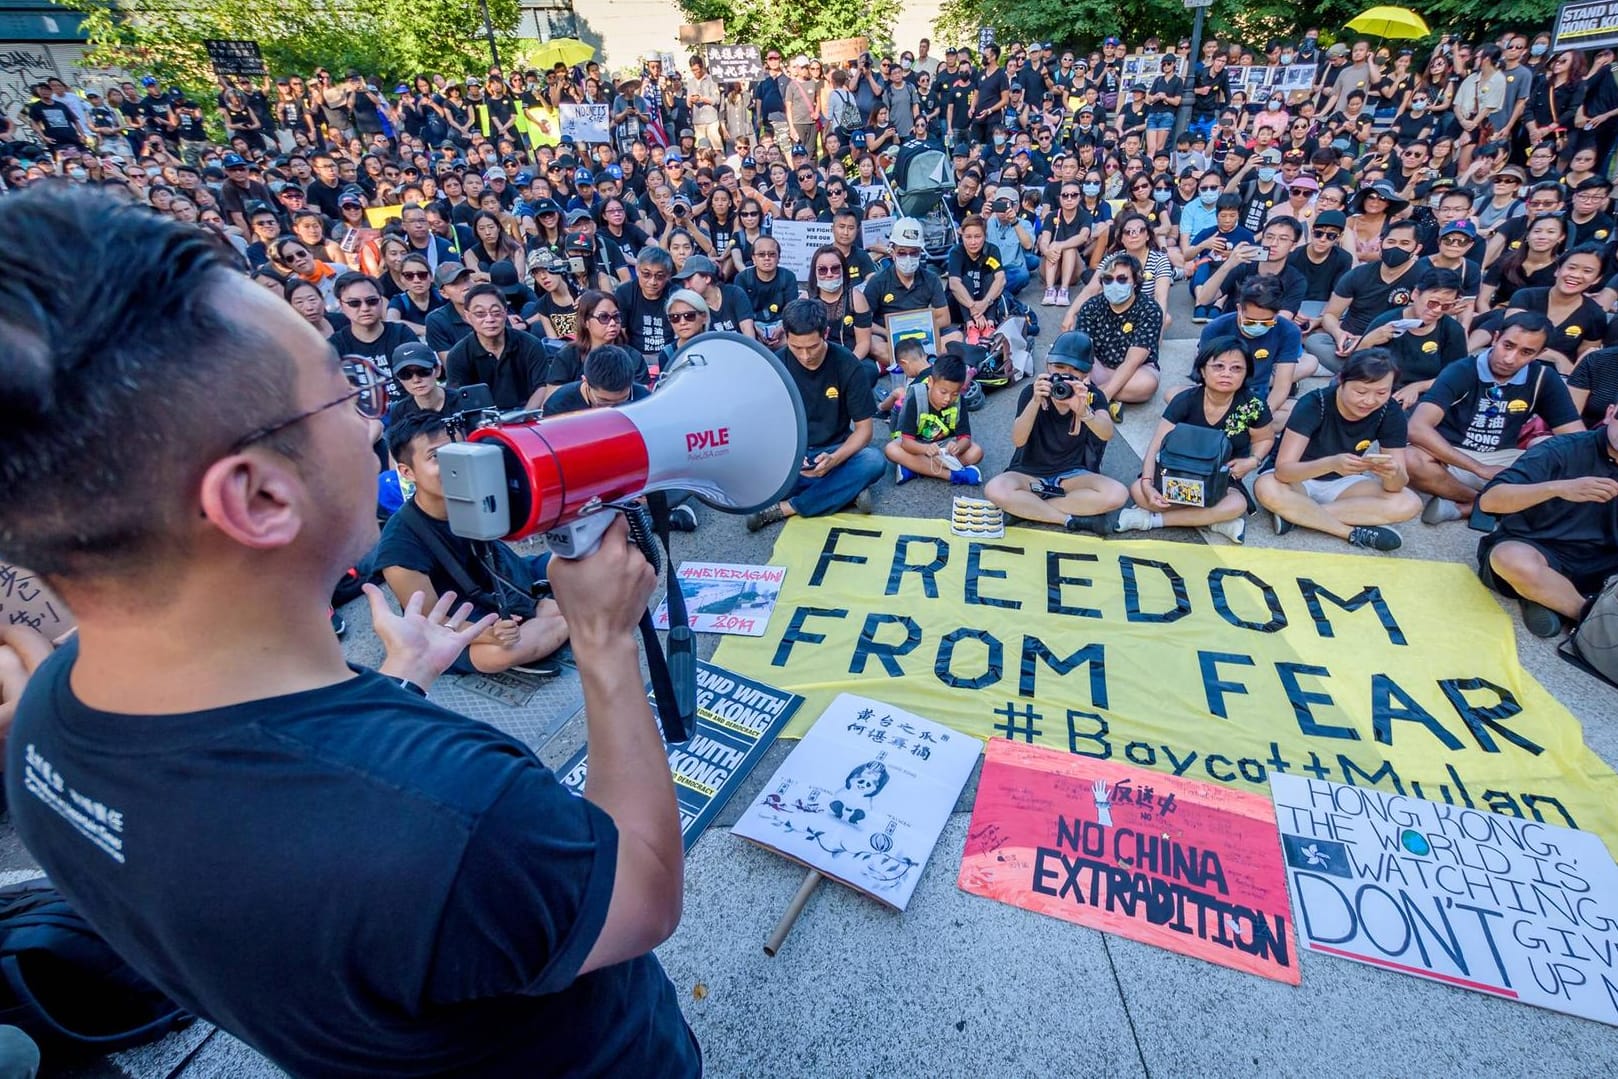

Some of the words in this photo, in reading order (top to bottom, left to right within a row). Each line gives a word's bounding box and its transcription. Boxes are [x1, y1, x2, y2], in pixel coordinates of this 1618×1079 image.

[1560, 19, 1599, 33] HONG
[1563, 5, 1607, 22] STAND
[686, 428, 729, 452] PYLE
[1465, 431, 1501, 446] HONG
[808, 527, 1408, 646] FREEDOM
[710, 614, 756, 633] 2019
[732, 684, 786, 715] WITH
[771, 606, 1109, 709] FROM
[1197, 650, 1545, 756] FEAR
[711, 697, 772, 733] KONG
[668, 749, 728, 791] KONG
[687, 734, 745, 770] WITH
[677, 775, 715, 796] DEMOCRACY
[1111, 778, 1178, 818] 反送中
[1308, 779, 1423, 828] HONG
[1056, 815, 1105, 857] NO
[1114, 828, 1230, 896] CHINA
[1278, 803, 1357, 844] THE
[1524, 854, 1592, 893] IS
[1032, 846, 1290, 968] EXTRADITION
[1347, 846, 1618, 932] WATCHING
[1294, 871, 1514, 989] DON'T
[1513, 919, 1618, 968] GIV
[1528, 956, 1587, 1001] UP
